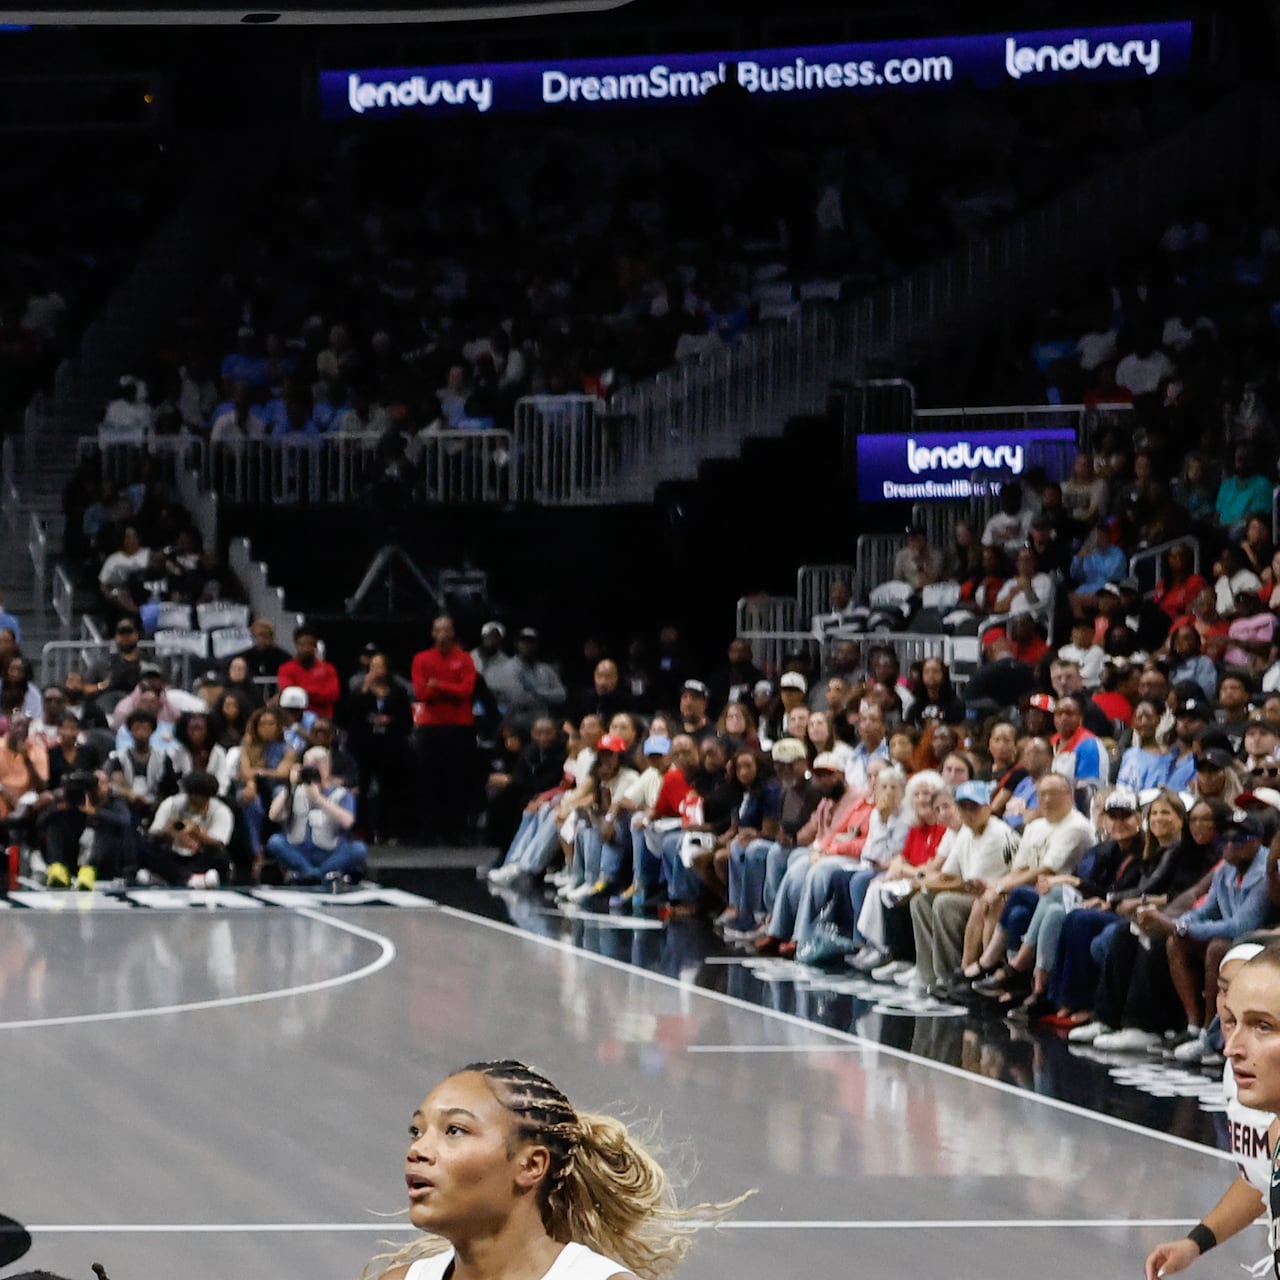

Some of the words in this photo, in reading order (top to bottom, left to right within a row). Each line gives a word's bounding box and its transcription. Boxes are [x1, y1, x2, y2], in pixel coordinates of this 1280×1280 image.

[348, 73, 493, 113] lendistry
[542, 54, 954, 102] DreamSmalBusiness.com
[1005, 37, 1160, 79] lendistry
[907, 439, 1025, 475] lendistry
